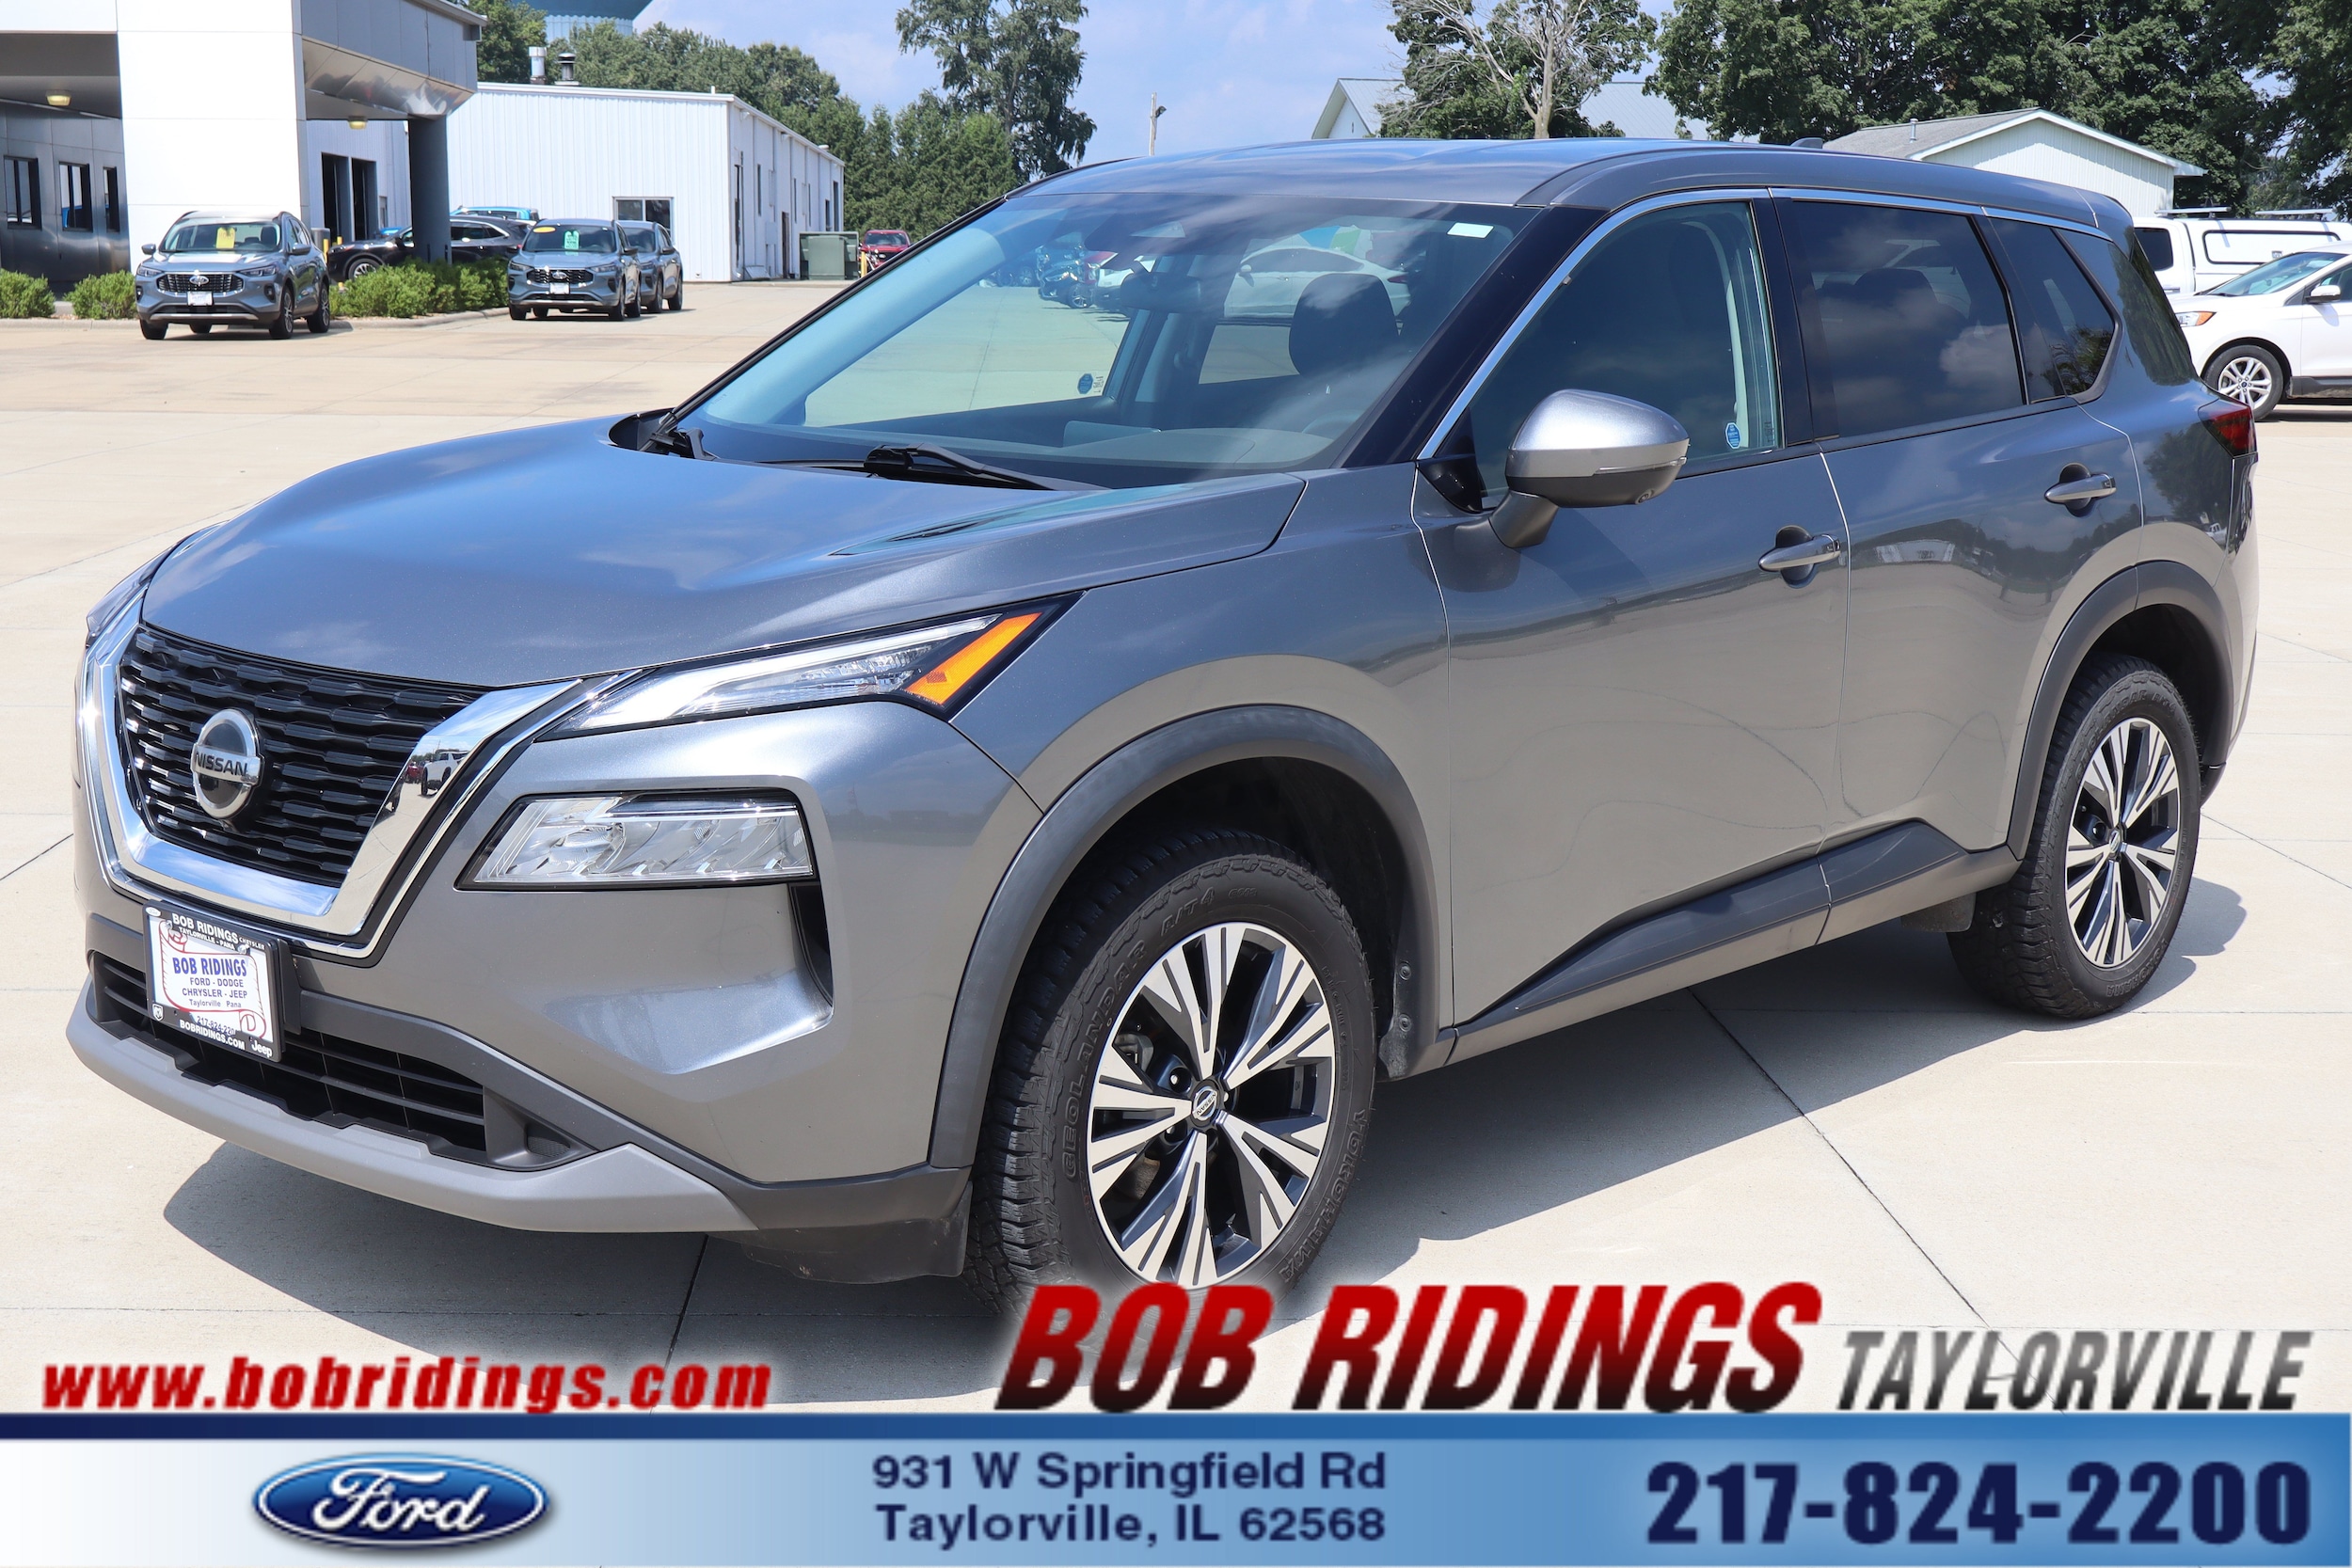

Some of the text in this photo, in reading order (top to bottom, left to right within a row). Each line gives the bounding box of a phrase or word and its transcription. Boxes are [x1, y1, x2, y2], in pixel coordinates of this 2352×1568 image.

[196, 751, 248, 777] NISSAN
[171, 912, 240, 944] BOB RIDINGS
[178, 927, 215, 944] TAYLORVILLE
[219, 940, 236, 951] PANA
[238, 936, 265, 950] CHRYSLER
[172, 957, 247, 977] BOB RIDINGS
[189, 977, 211, 987] FORD
[216, 978, 245, 988] DODGE
[182, 988, 223, 998] CHRYSLER
[229, 990, 248, 999] JEEP
[188, 998, 242, 1008] Taylorville Pana
[179, 1019, 246, 1051] BOBRIDINGS.COM
[197, 1016, 235, 1036] 217-824-220
[251, 1039, 273, 1058] Jeep
[1061, 939, 1149, 1181] GEOLANDAR
